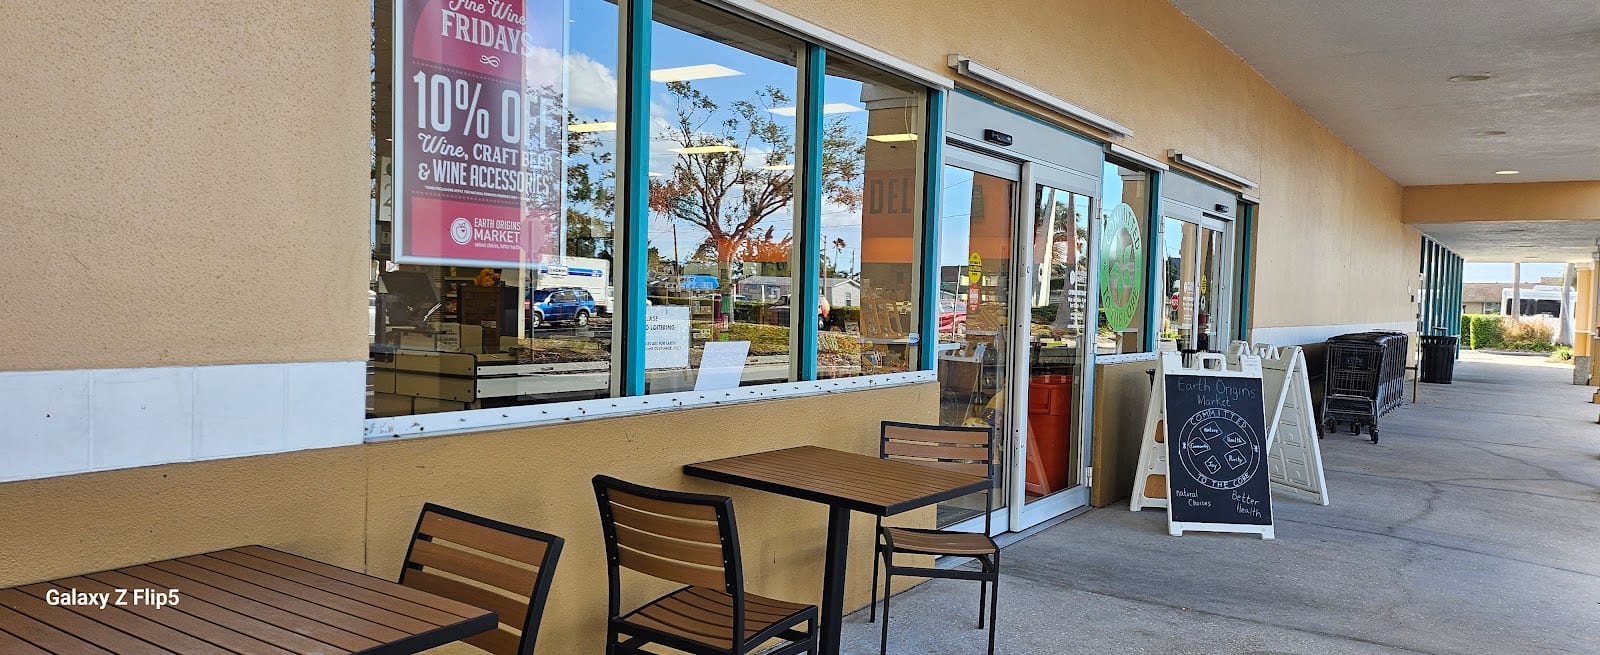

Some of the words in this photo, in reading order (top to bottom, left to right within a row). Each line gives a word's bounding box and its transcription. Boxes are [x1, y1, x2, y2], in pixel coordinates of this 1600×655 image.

[449, 0, 485, 14] Fine
[487, 0, 527, 27] Wine
[441, 8, 533, 57] FRIDAYS
[413, 70, 490, 140] 10%
[501, 89, 556, 150] OFF
[418, 133, 469, 161] Wine,
[473, 143, 519, 167] CRAFT
[521, 150, 553, 172] BEER
[418, 162, 431, 181] &
[432, 158, 467, 186] WINE
[869, 177, 912, 214] DEL
[474, 217, 495, 229] EARTH
[495, 219, 521, 231] ORIGINS
[474, 228, 521, 244] MARKET
[1178, 376, 1211, 393] Earth
[1216, 378, 1256, 401] Origins
[1197, 393, 1231, 408] Market
[1190, 408, 1248, 428] COMMITTED
[1197, 473, 1208, 484] TO
[1211, 480, 1230, 489] THE
[1232, 472, 1250, 487] CORE
[1187, 498, 1212, 507] Choices
[1231, 489, 1260, 506] Better
[1236, 501, 1263, 519] Health
